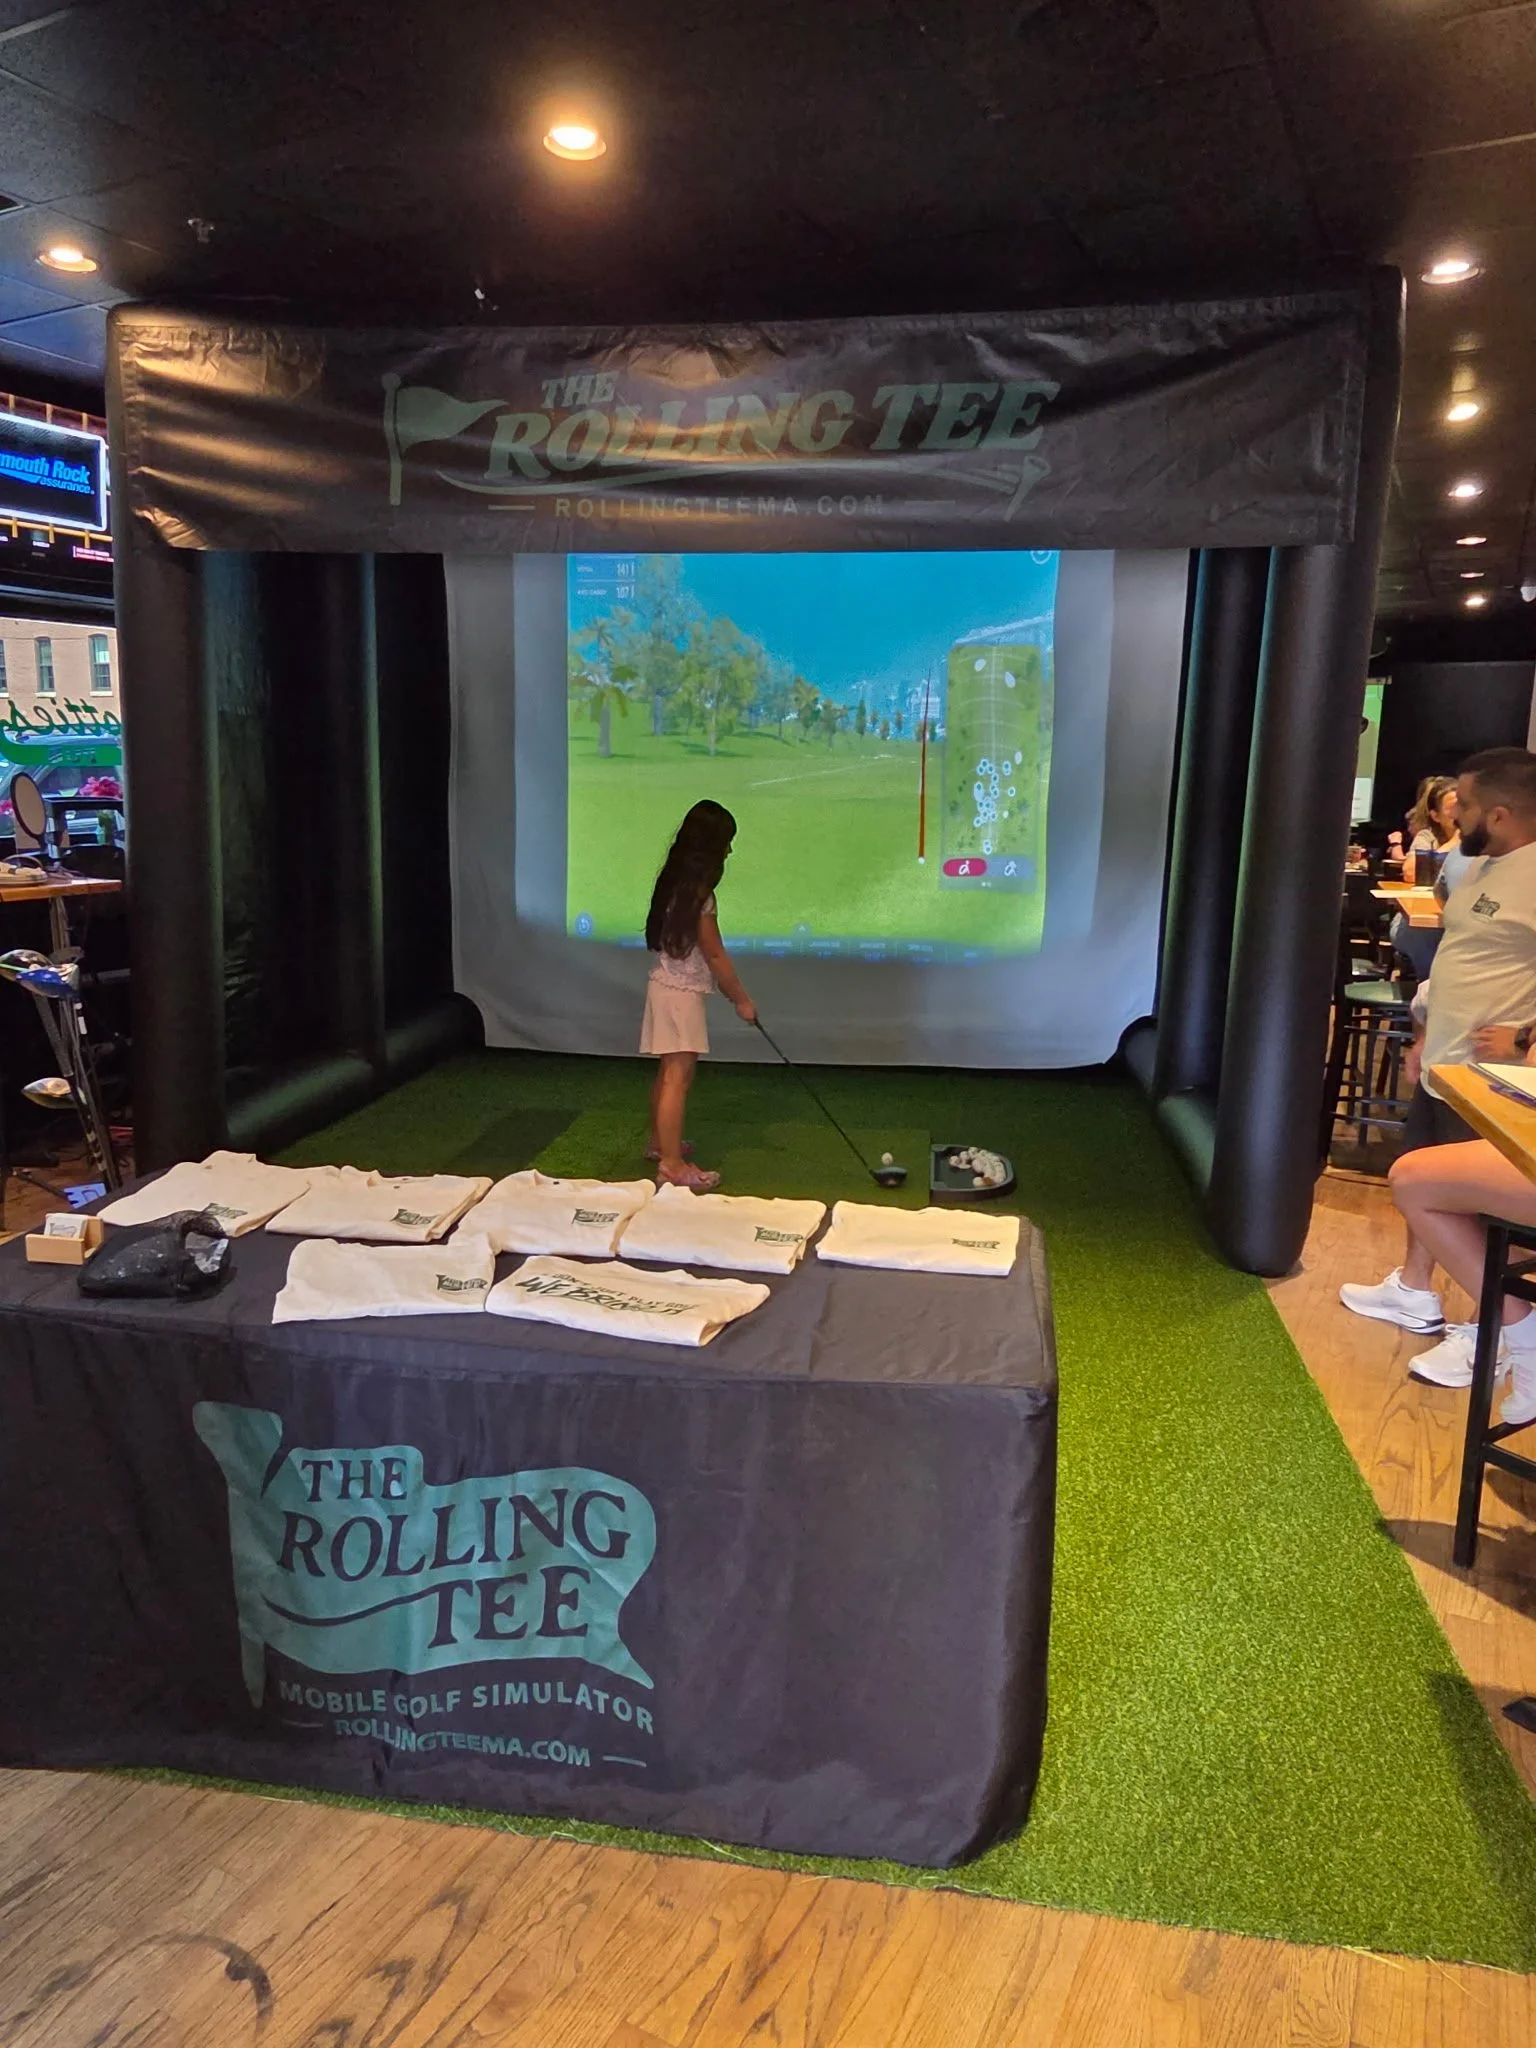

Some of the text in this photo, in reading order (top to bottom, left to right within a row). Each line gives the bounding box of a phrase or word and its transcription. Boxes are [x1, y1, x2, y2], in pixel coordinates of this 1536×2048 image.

[541, 370, 620, 408] THE
[484, 381, 1061, 480] ROLLING TEE
[52, 460, 91, 484] Rock
[555, 494, 883, 518] ROLLINGTEEMA.COM
[515, 1276, 571, 1295] WE
[301, 1457, 409, 1502] THE
[276, 1487, 632, 1582] ROLLING
[427, 1565, 592, 1649] TEE
[279, 1680, 655, 1735] MOBILE GOLF SIMULATOR
[334, 1718, 592, 1768] ROLLINGTEEMA.COM
